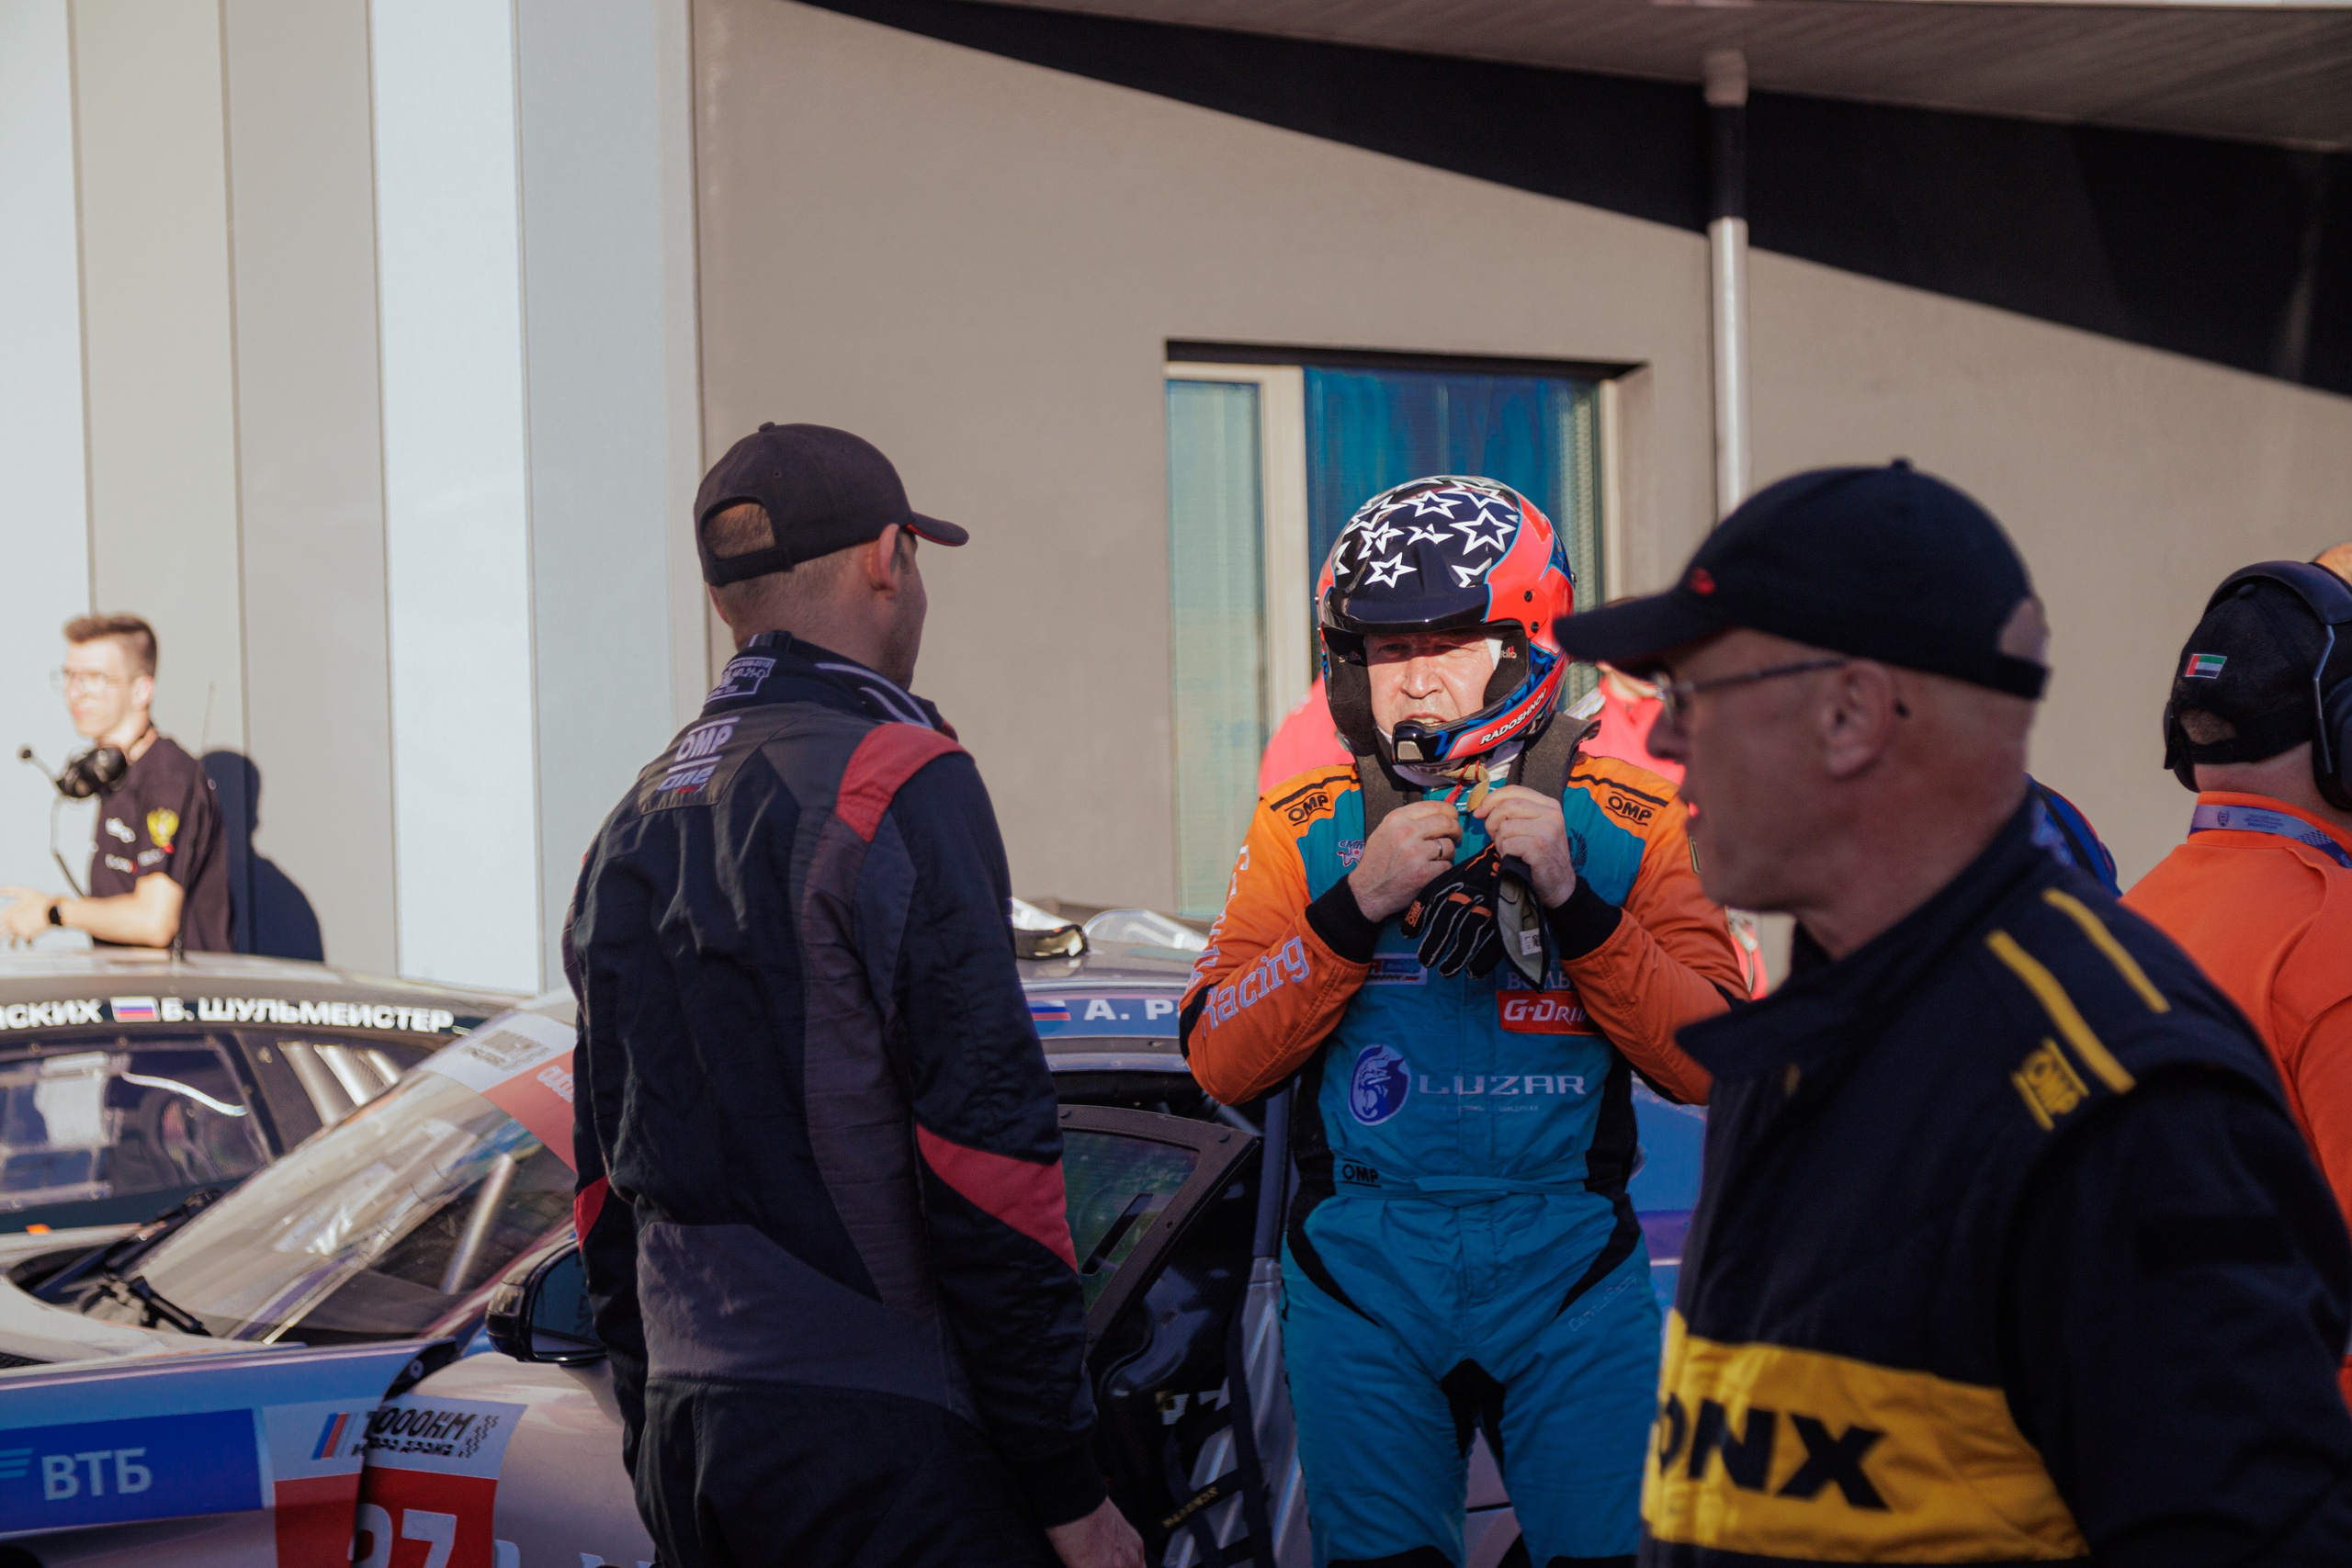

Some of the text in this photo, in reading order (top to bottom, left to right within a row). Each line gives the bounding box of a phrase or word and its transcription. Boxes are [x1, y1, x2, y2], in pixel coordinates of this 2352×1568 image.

[1480, 688, 1548, 746] RADOSHNOV
[674, 725, 733, 762] OMP
[1288, 794, 1329, 822] OMP
[1608, 795, 1653, 822] OMP
[1408, 901, 1423, 926] OMP
[160, 997, 195, 1022] Б.
[1419, 1075, 1588, 1096] LUZAR
[1341, 1163, 1379, 1184] OMP
[42, 1448, 152, 1501] ВТБ
